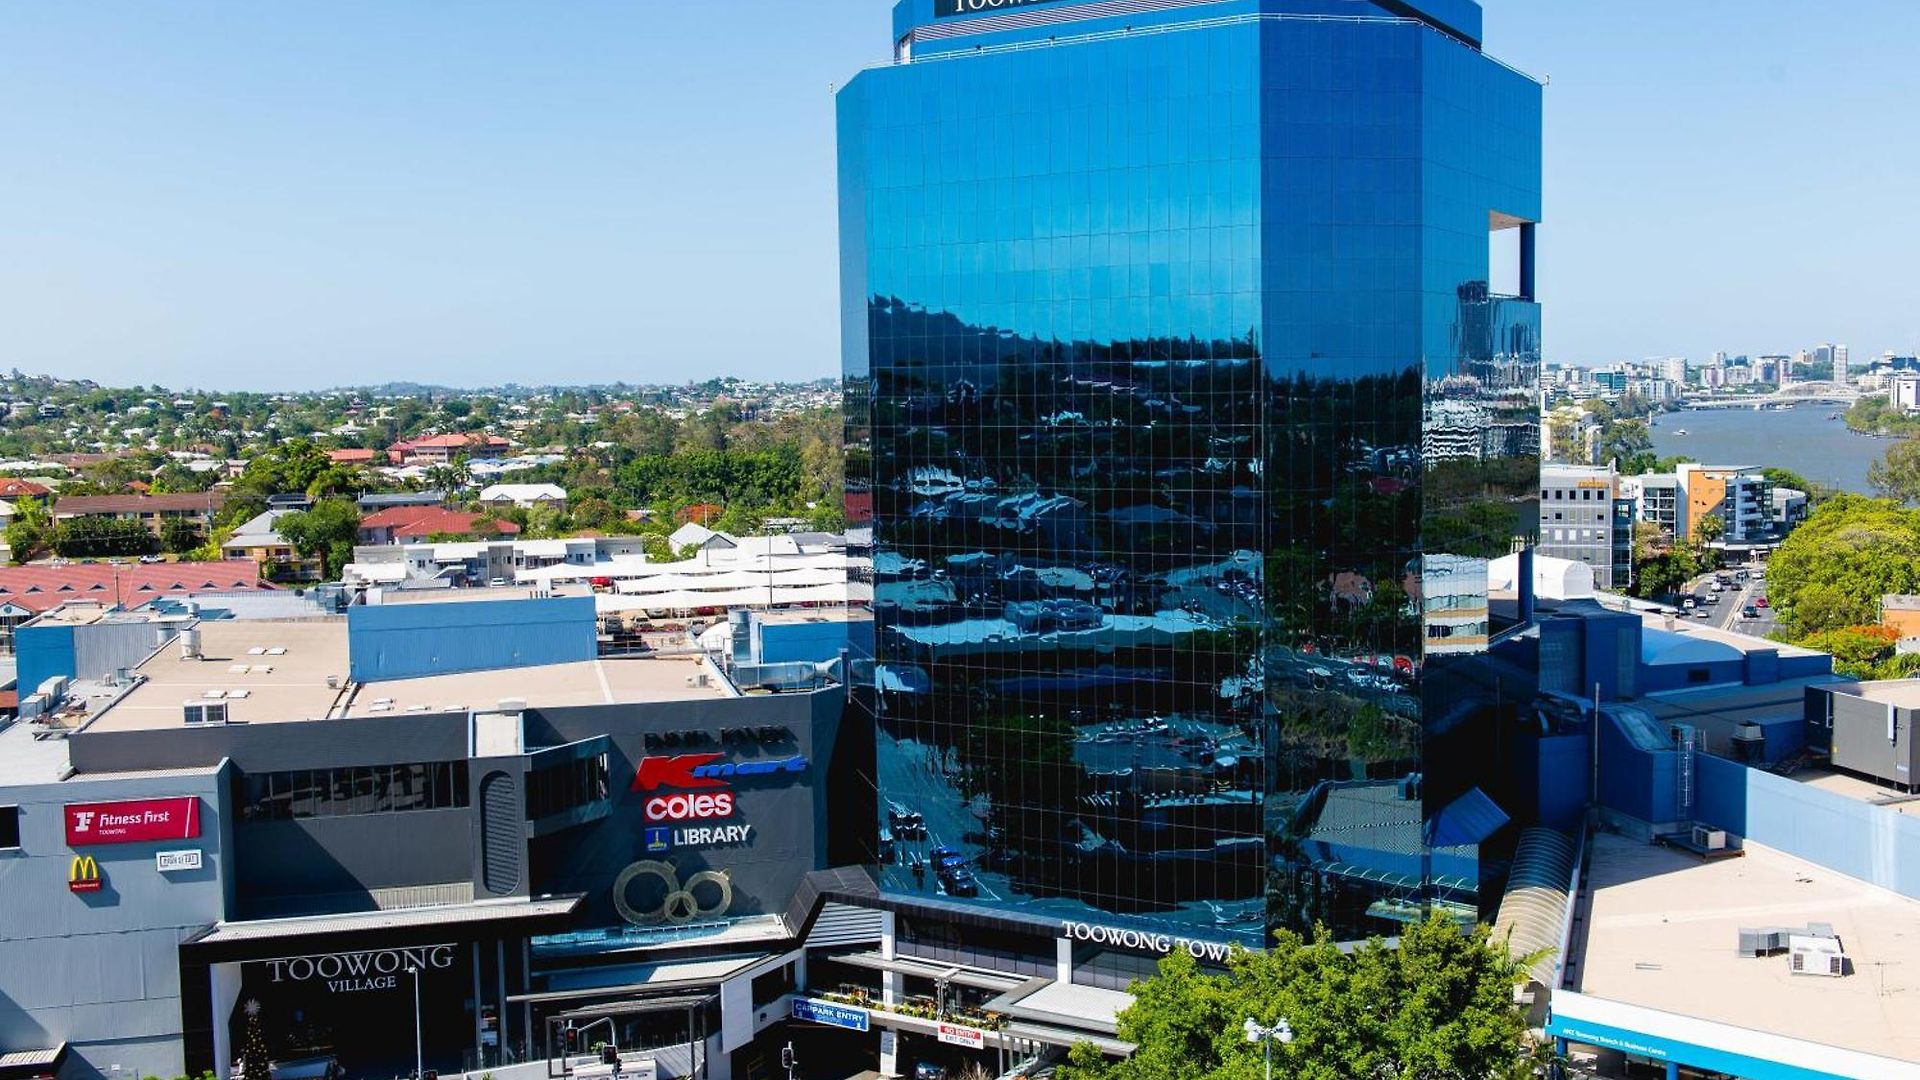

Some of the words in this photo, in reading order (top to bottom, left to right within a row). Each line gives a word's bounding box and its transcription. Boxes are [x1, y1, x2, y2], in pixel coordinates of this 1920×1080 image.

[646, 794, 732, 820] coles
[674, 824, 751, 846] LIBRARY
[1062, 921, 1171, 952] TOOWONG
[266, 945, 454, 982] TOOWONG
[328, 976, 397, 992] VILLAGE
[836, 1011, 864, 1021] ENTRY
